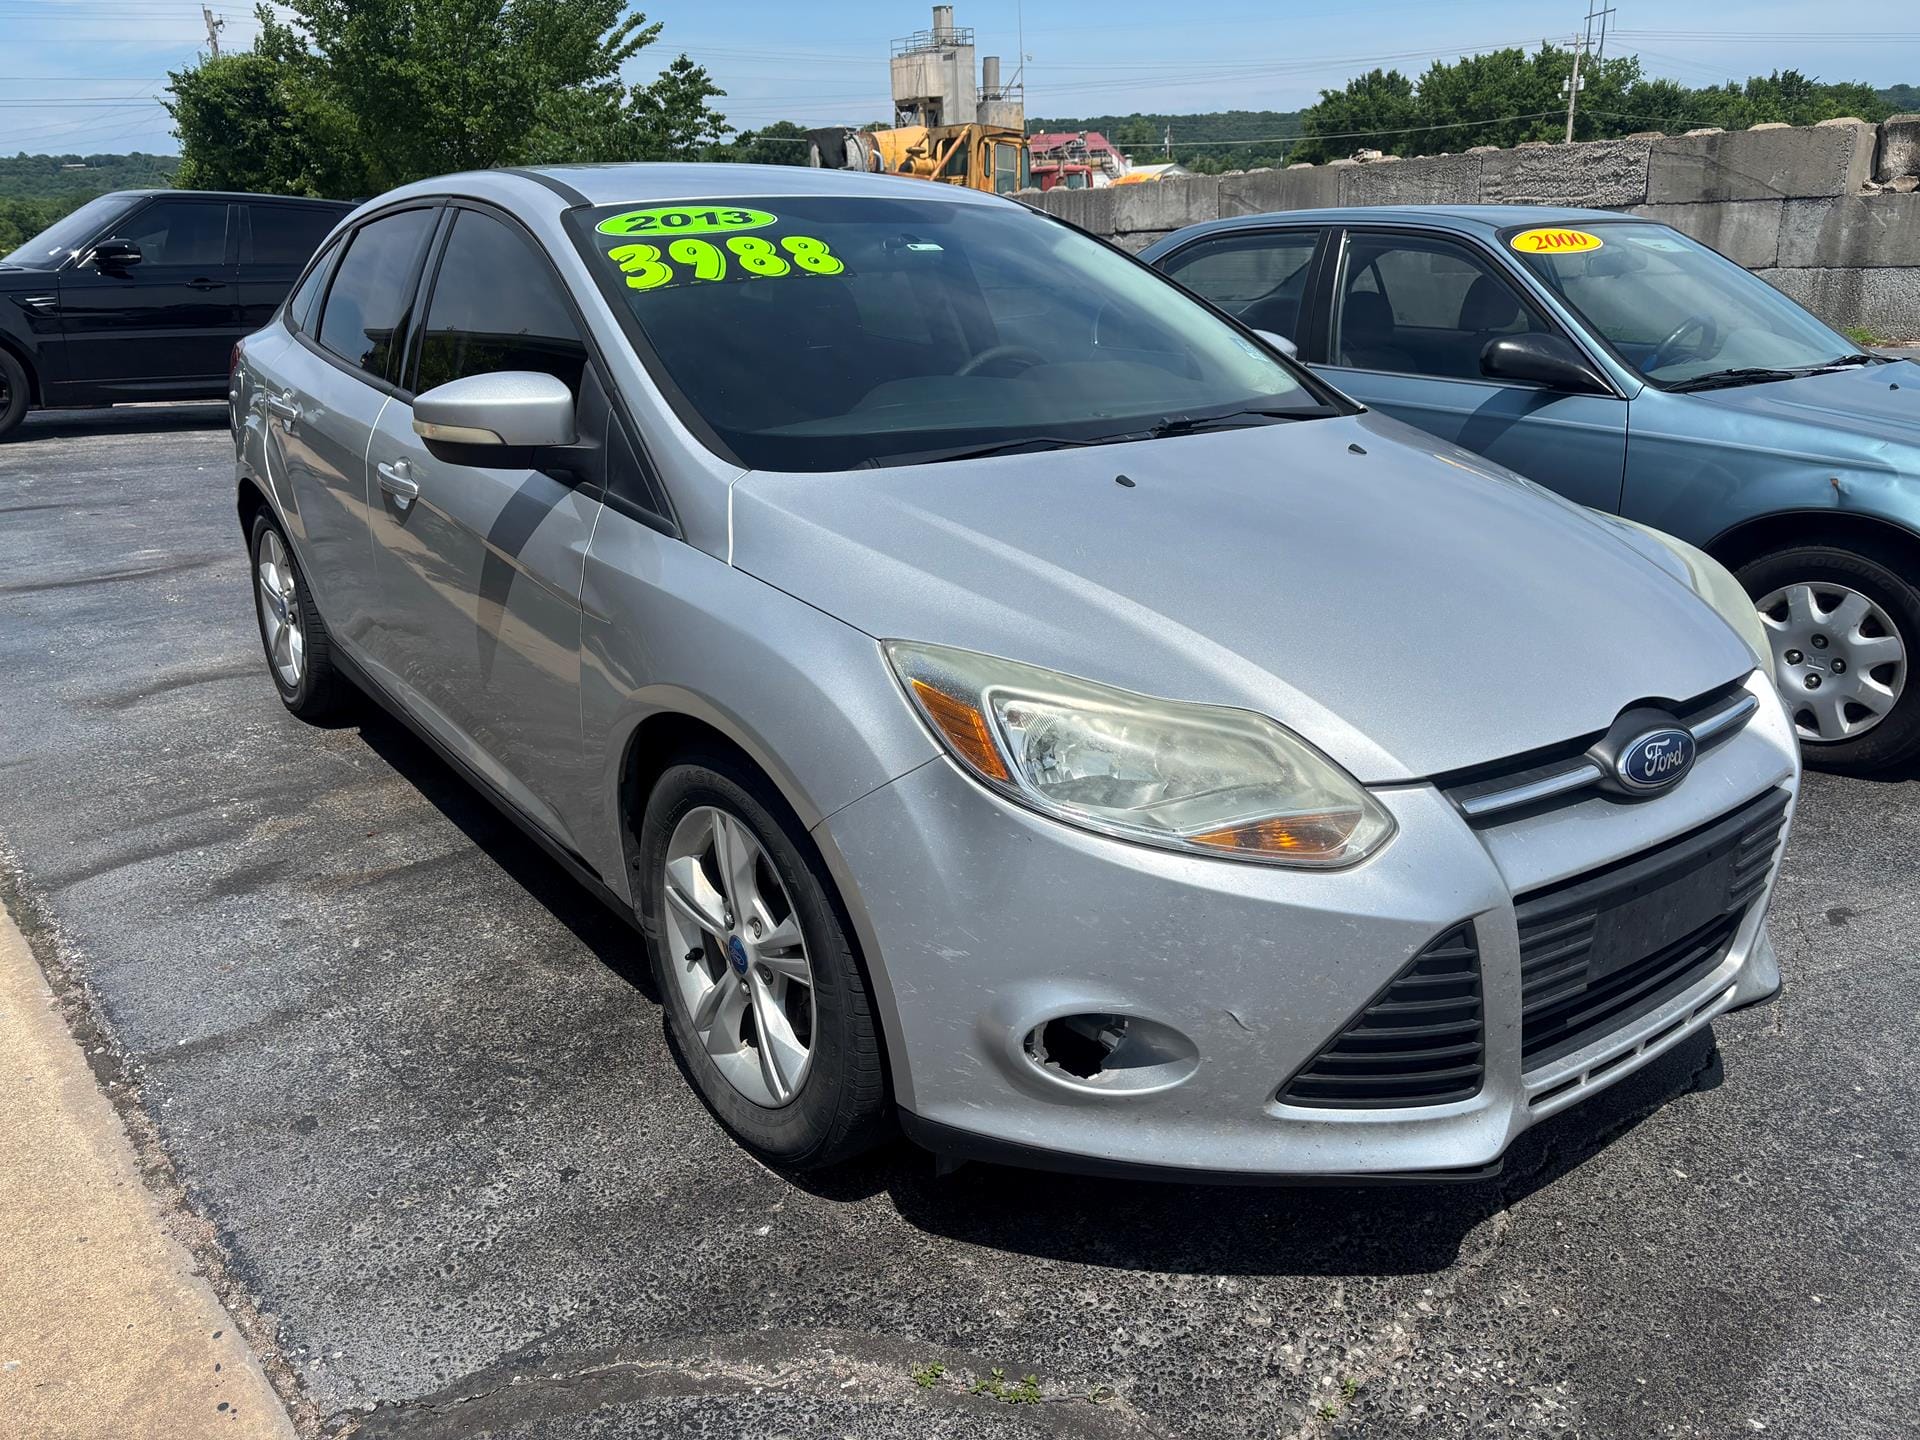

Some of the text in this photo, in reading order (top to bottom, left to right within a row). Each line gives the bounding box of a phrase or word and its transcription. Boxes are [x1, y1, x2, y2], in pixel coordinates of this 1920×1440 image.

[625, 210, 754, 232] 2013
[1529, 233, 1588, 250] 2000
[607, 236, 845, 290] 3988
[1645, 738, 1684, 777] Ford
